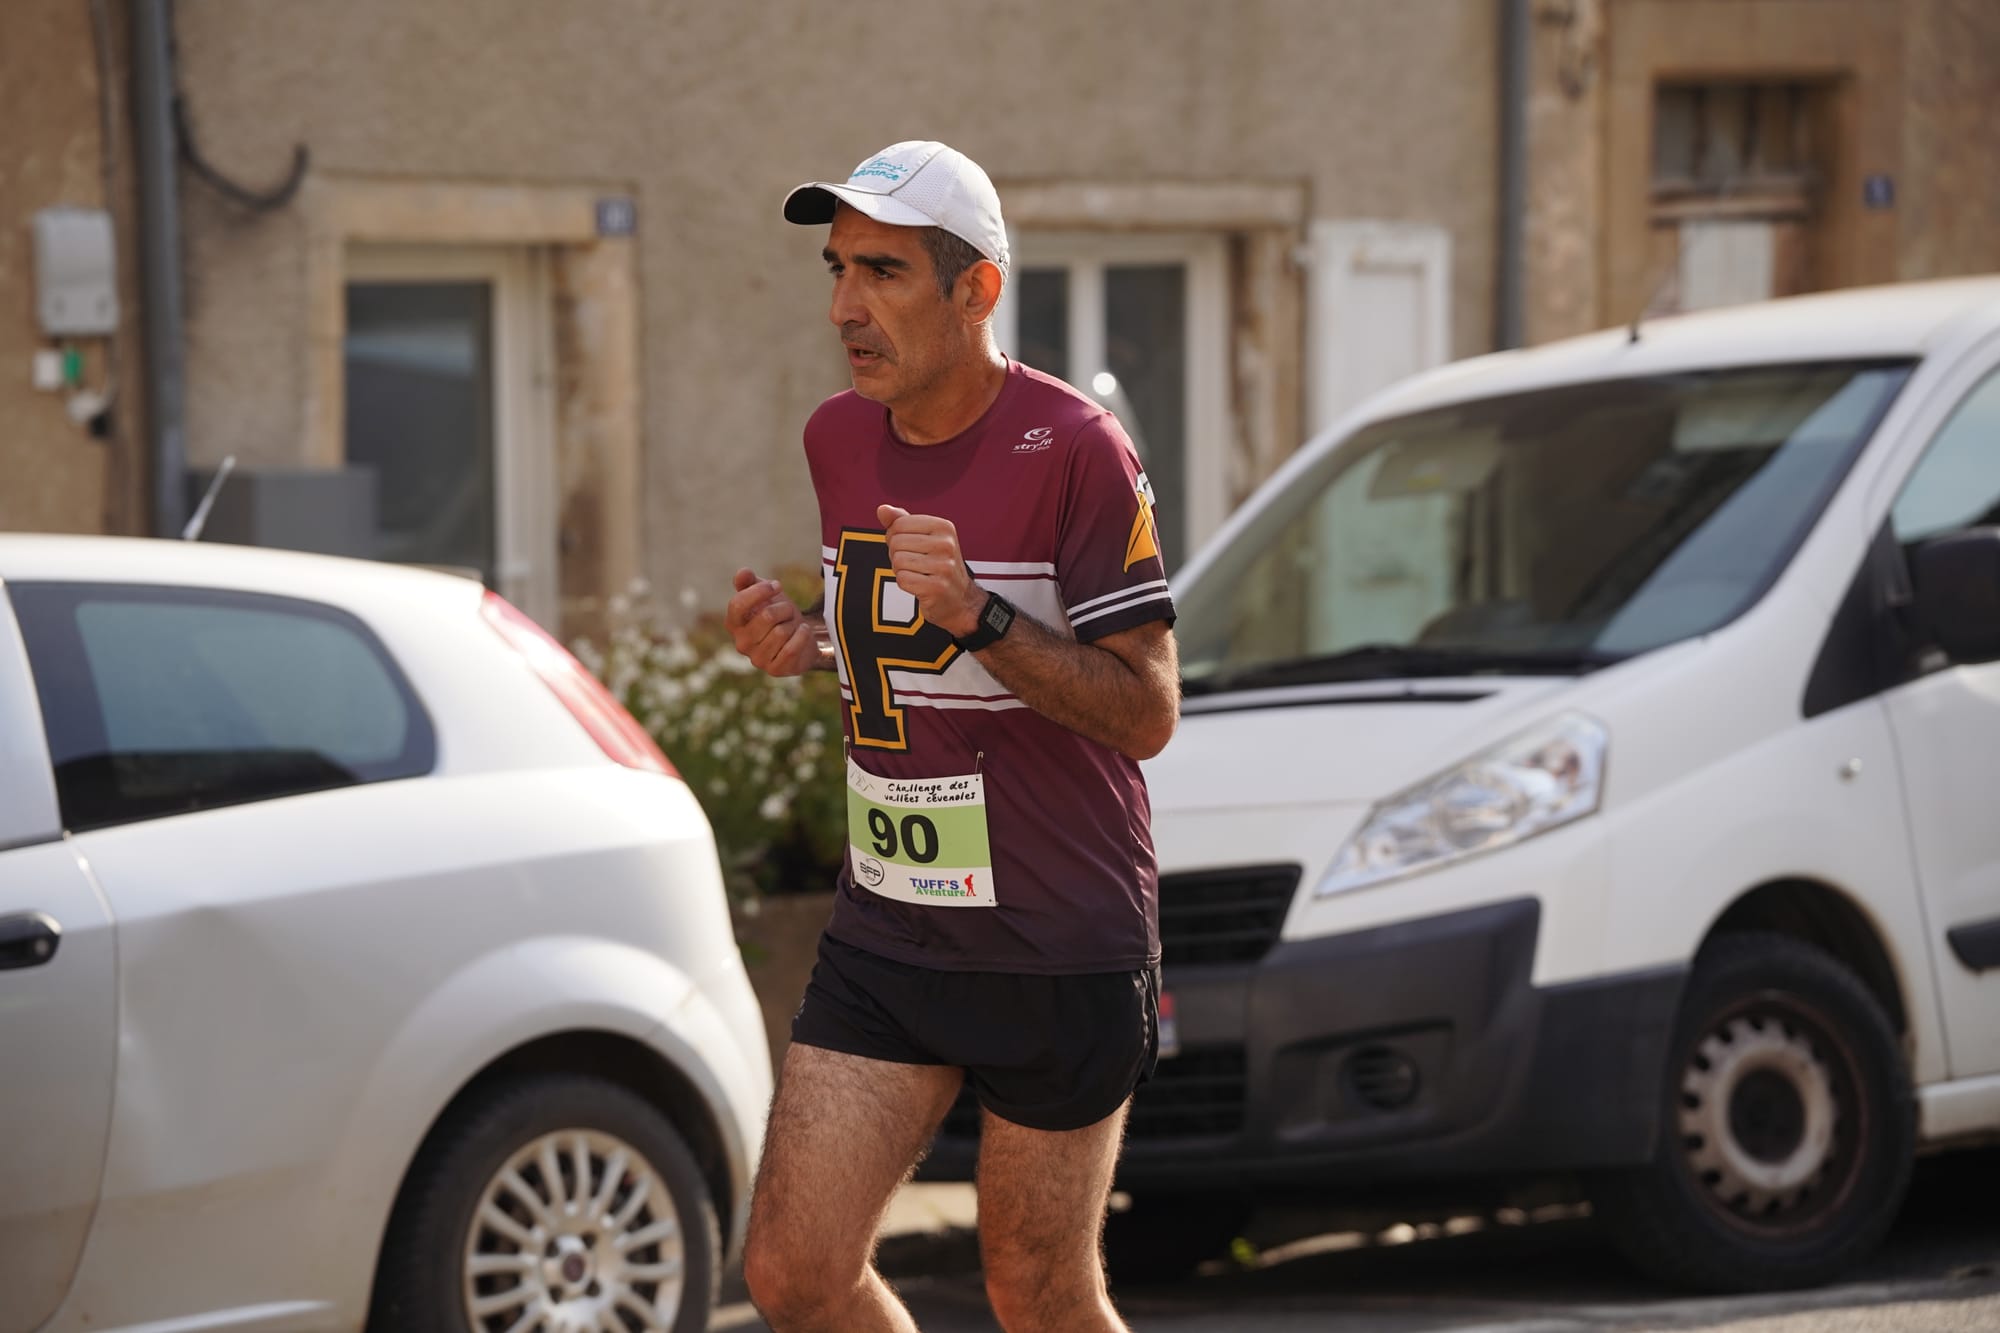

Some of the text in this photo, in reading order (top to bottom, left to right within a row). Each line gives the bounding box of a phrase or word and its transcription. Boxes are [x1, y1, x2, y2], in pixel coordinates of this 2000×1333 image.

[833, 527, 966, 754] P
[887, 780, 969, 796] Challenge des
[884, 791, 976, 803] vallées cévenoles
[867, 807, 939, 864] 90
[909, 877, 960, 890] TUFF'S
[915, 885, 966, 897] Aventure
